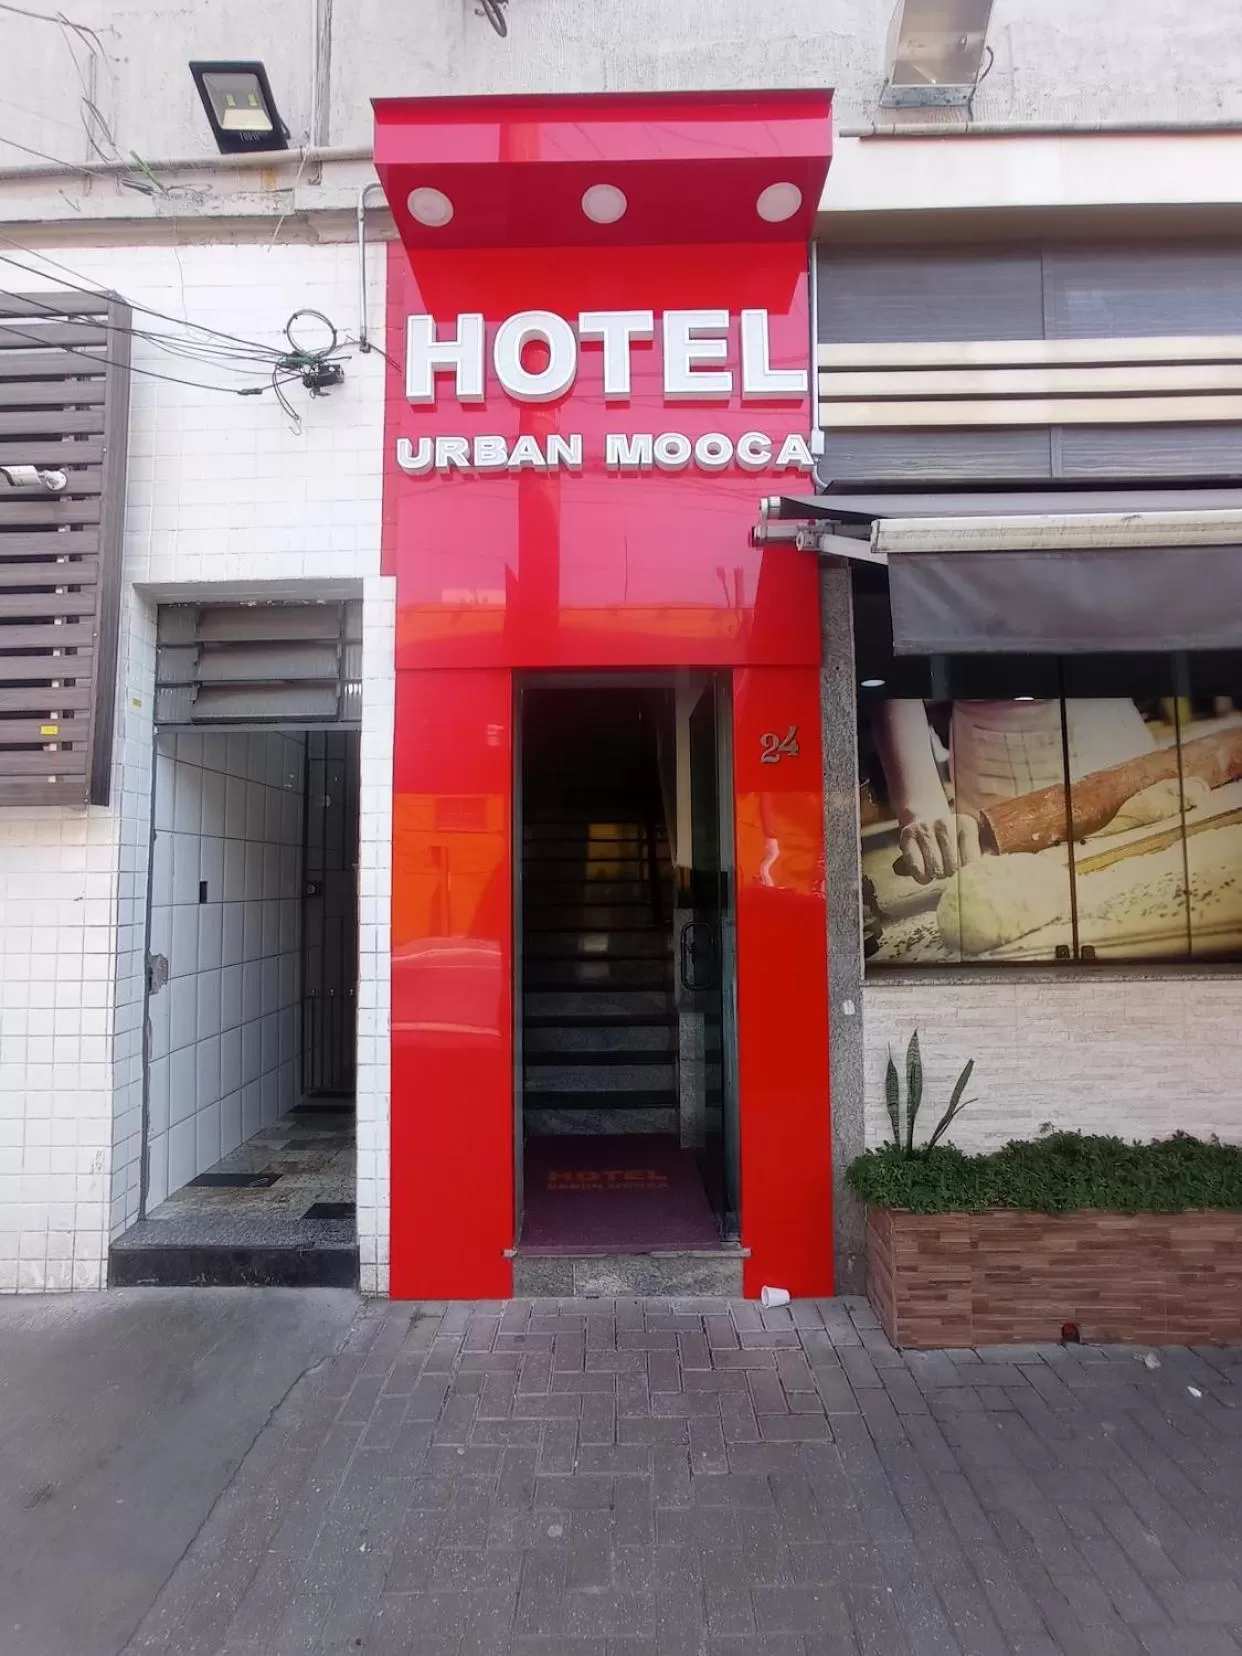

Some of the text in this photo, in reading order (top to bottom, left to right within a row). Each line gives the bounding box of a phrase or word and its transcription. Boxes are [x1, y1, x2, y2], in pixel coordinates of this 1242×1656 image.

[405, 309, 809, 404] HOTEL
[396, 431, 814, 475] URBAN MOOCA
[760, 725, 799, 763] 24
[548, 1169, 669, 1181] HOTEL
